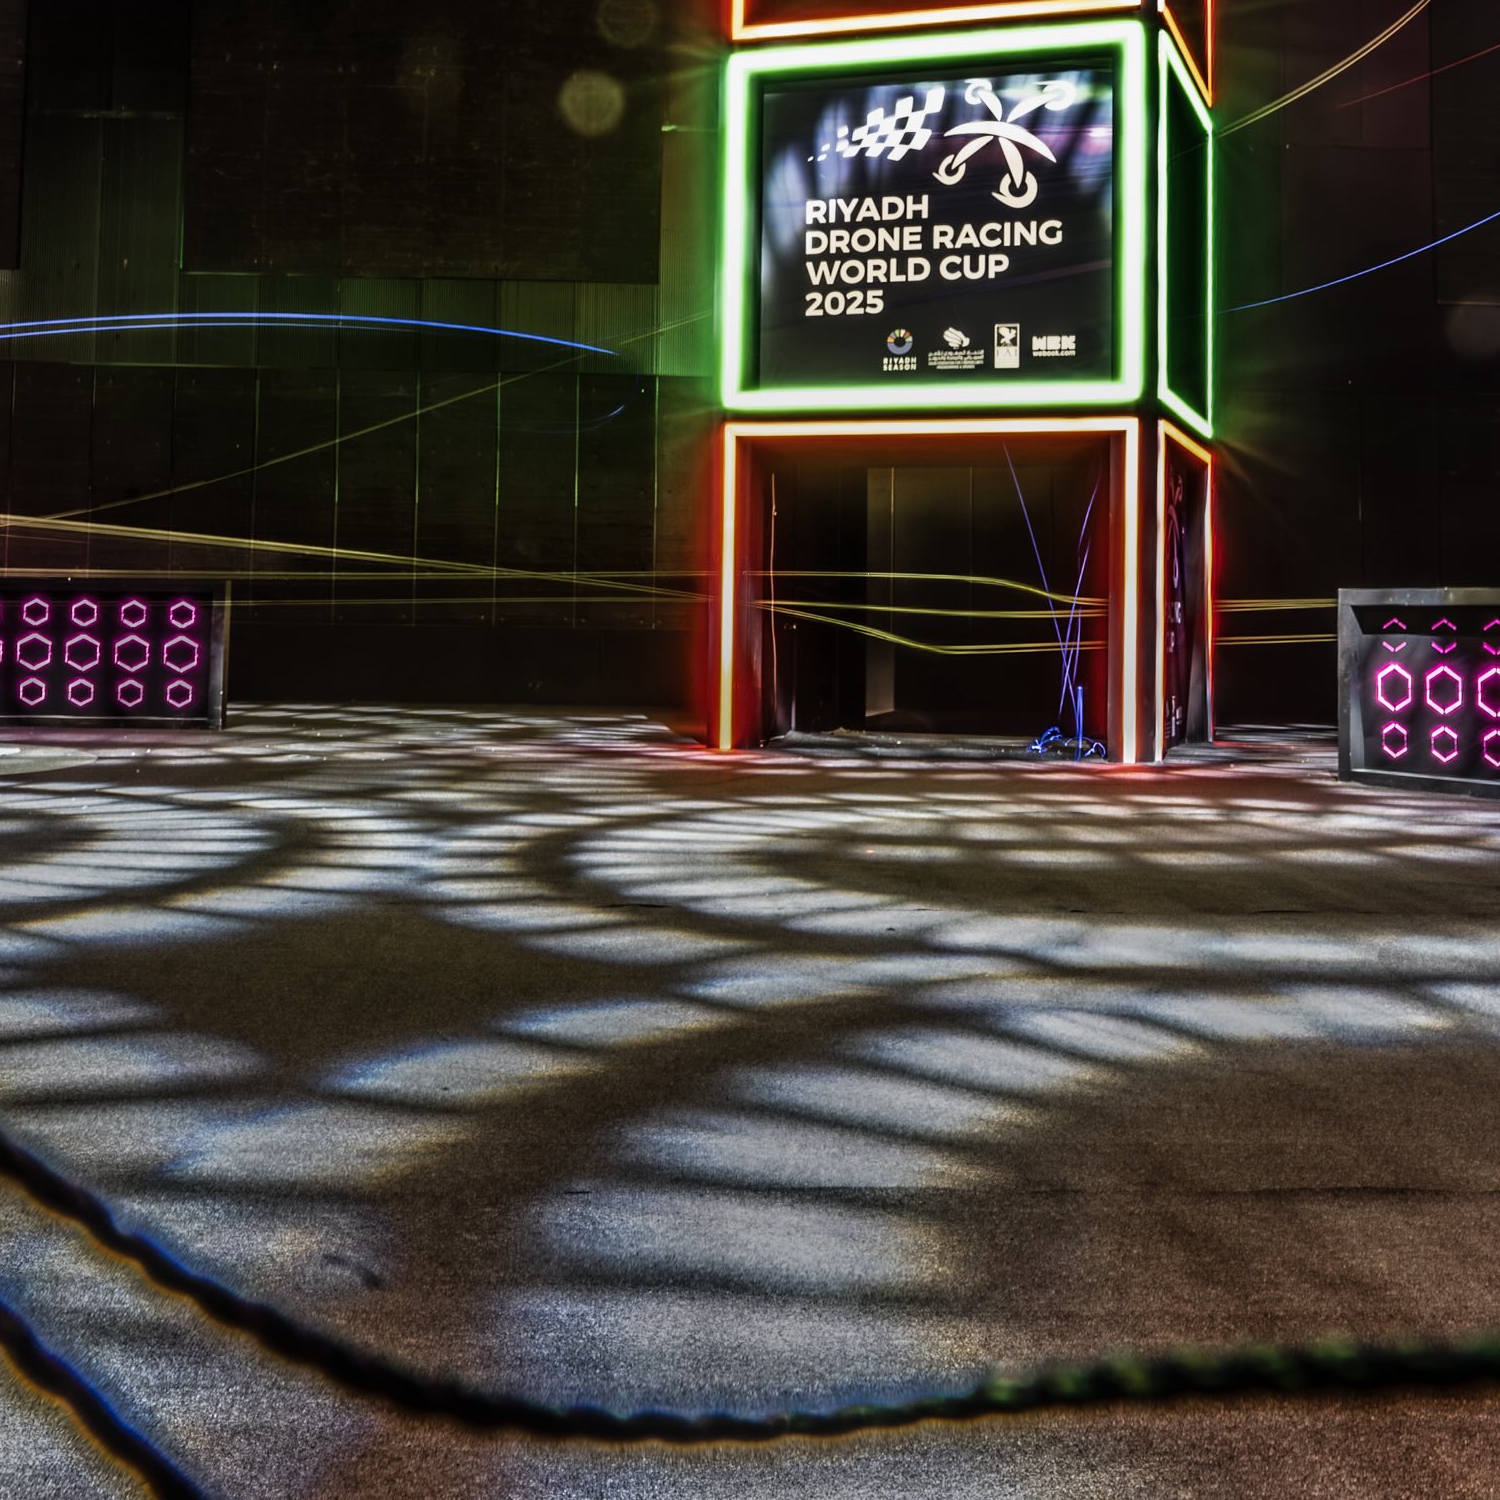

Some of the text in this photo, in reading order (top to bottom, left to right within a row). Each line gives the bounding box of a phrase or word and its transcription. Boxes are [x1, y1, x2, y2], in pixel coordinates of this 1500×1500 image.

[805, 194, 929, 224] RIYADH
[805, 219, 1063, 255] DRONE RACING
[805, 253, 1010, 286] WORLD CUP
[804, 289, 885, 317] 2025
[1032, 335, 1076, 350] WBK
